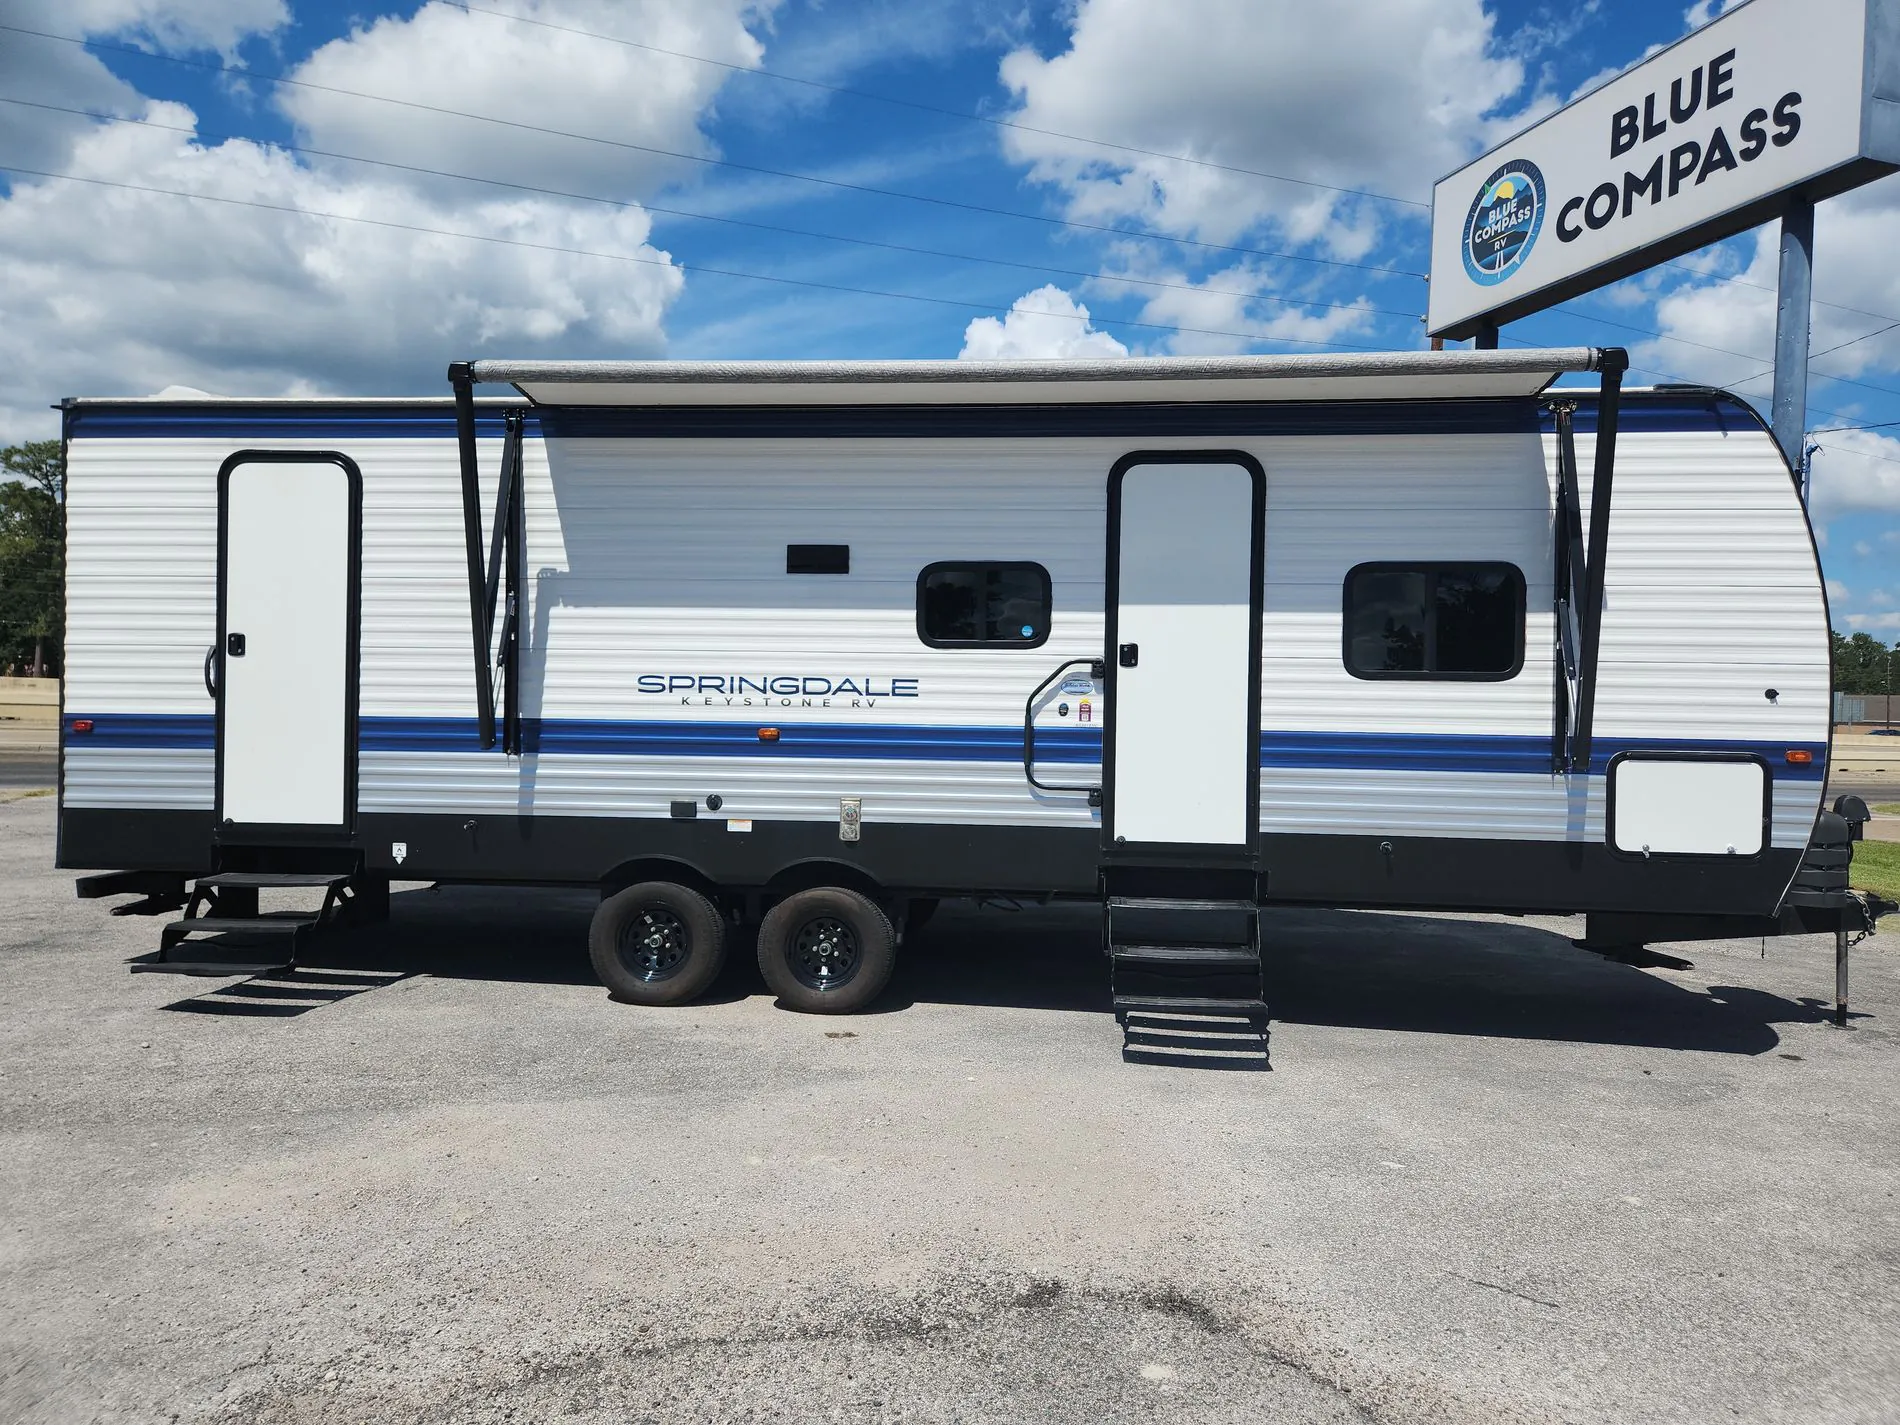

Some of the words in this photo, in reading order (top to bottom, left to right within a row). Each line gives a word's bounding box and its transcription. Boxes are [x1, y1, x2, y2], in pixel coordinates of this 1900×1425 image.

[1610, 48, 1736, 160] BLUE
[1555, 91, 1802, 243] COMPASS
[1488, 198, 1518, 224] BLUE
[1474, 207, 1531, 244] COMPASS
[1494, 237, 1507, 251] RV
[637, 675, 919, 697] SPRINGDALE
[681, 697, 831, 708] KEYSTONE
[852, 699, 877, 708] RV
